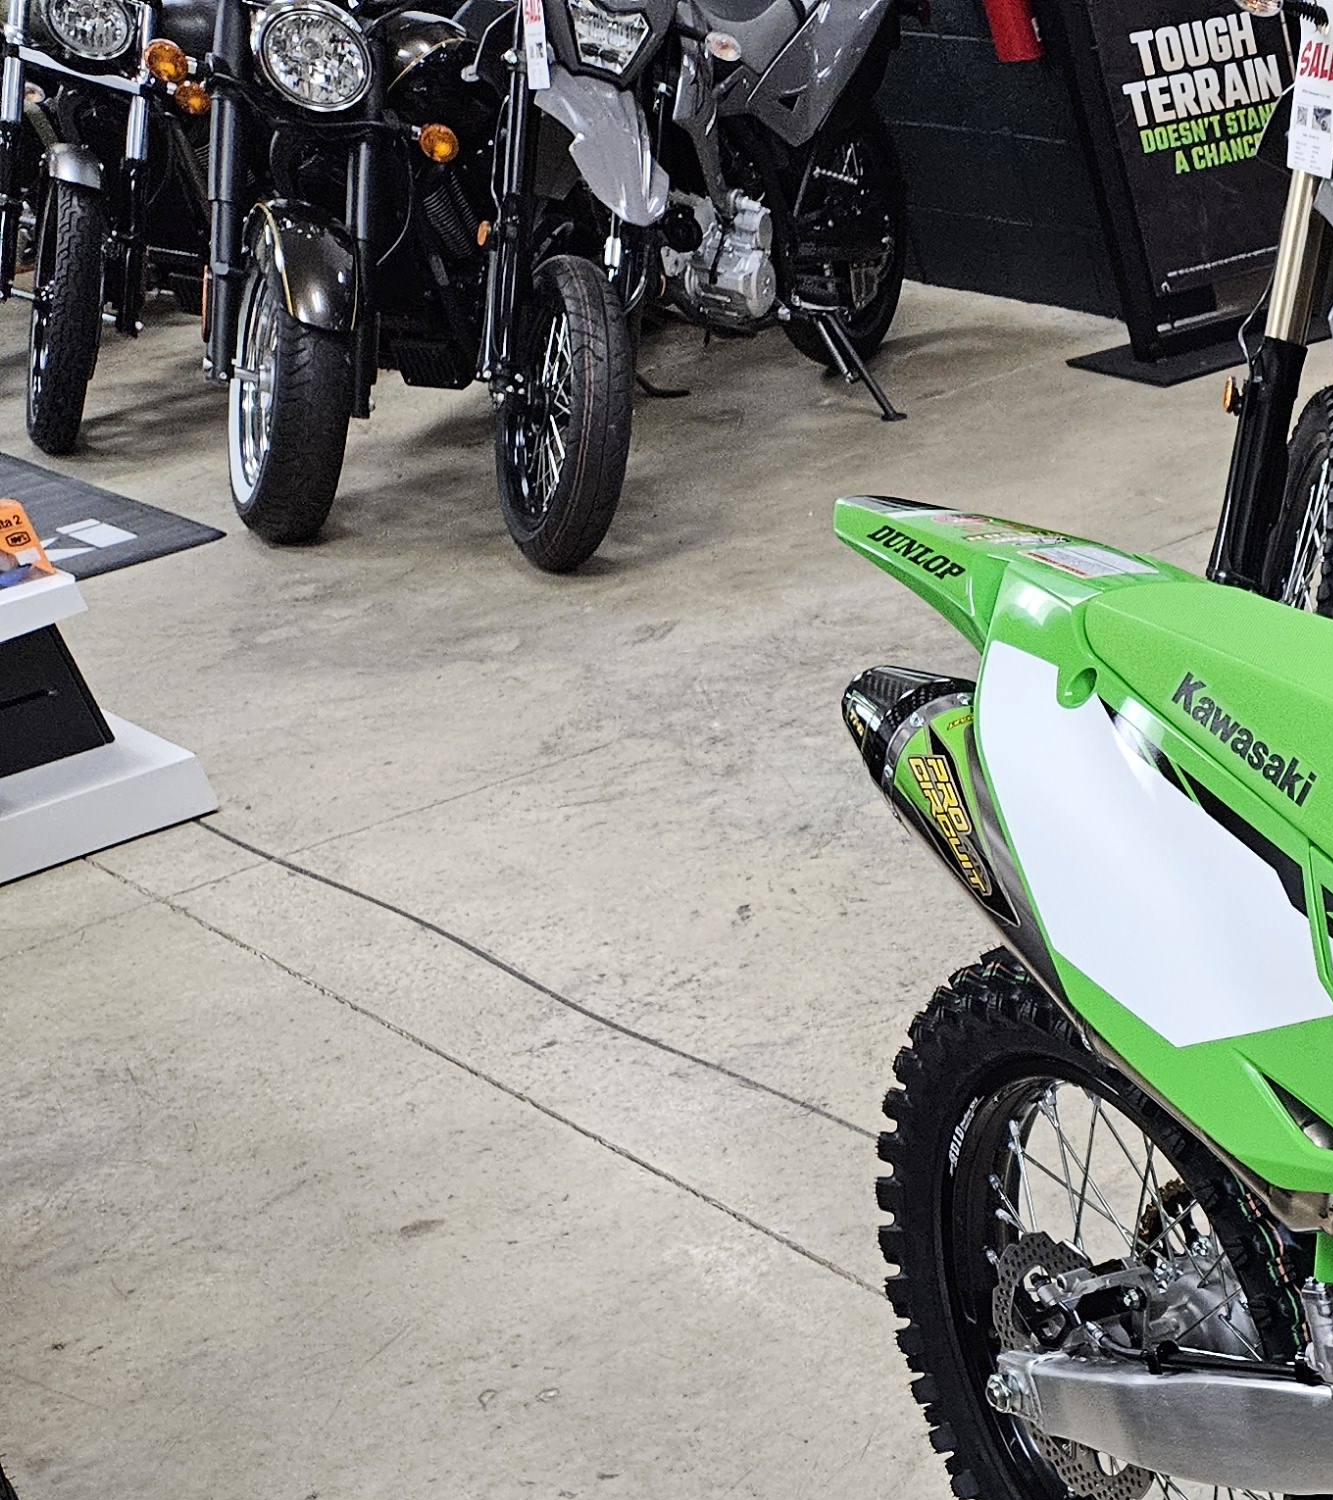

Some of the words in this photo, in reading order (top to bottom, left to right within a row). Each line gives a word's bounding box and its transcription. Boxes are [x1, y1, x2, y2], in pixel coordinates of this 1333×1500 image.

[1129, 12, 1257, 76] TOUGH
[1122, 54, 1283, 127] TERRAIN
[1140, 114, 1222, 154] DOESN'T
[1225, 102, 1277, 140] STAN
[1175, 150, 1191, 174] A
[867, 525, 966, 581] DUNLOP
[1171, 671, 1317, 808] Kawasaki
[907, 756, 988, 896] CIRCUIT
[926, 756, 970, 834] PRO
